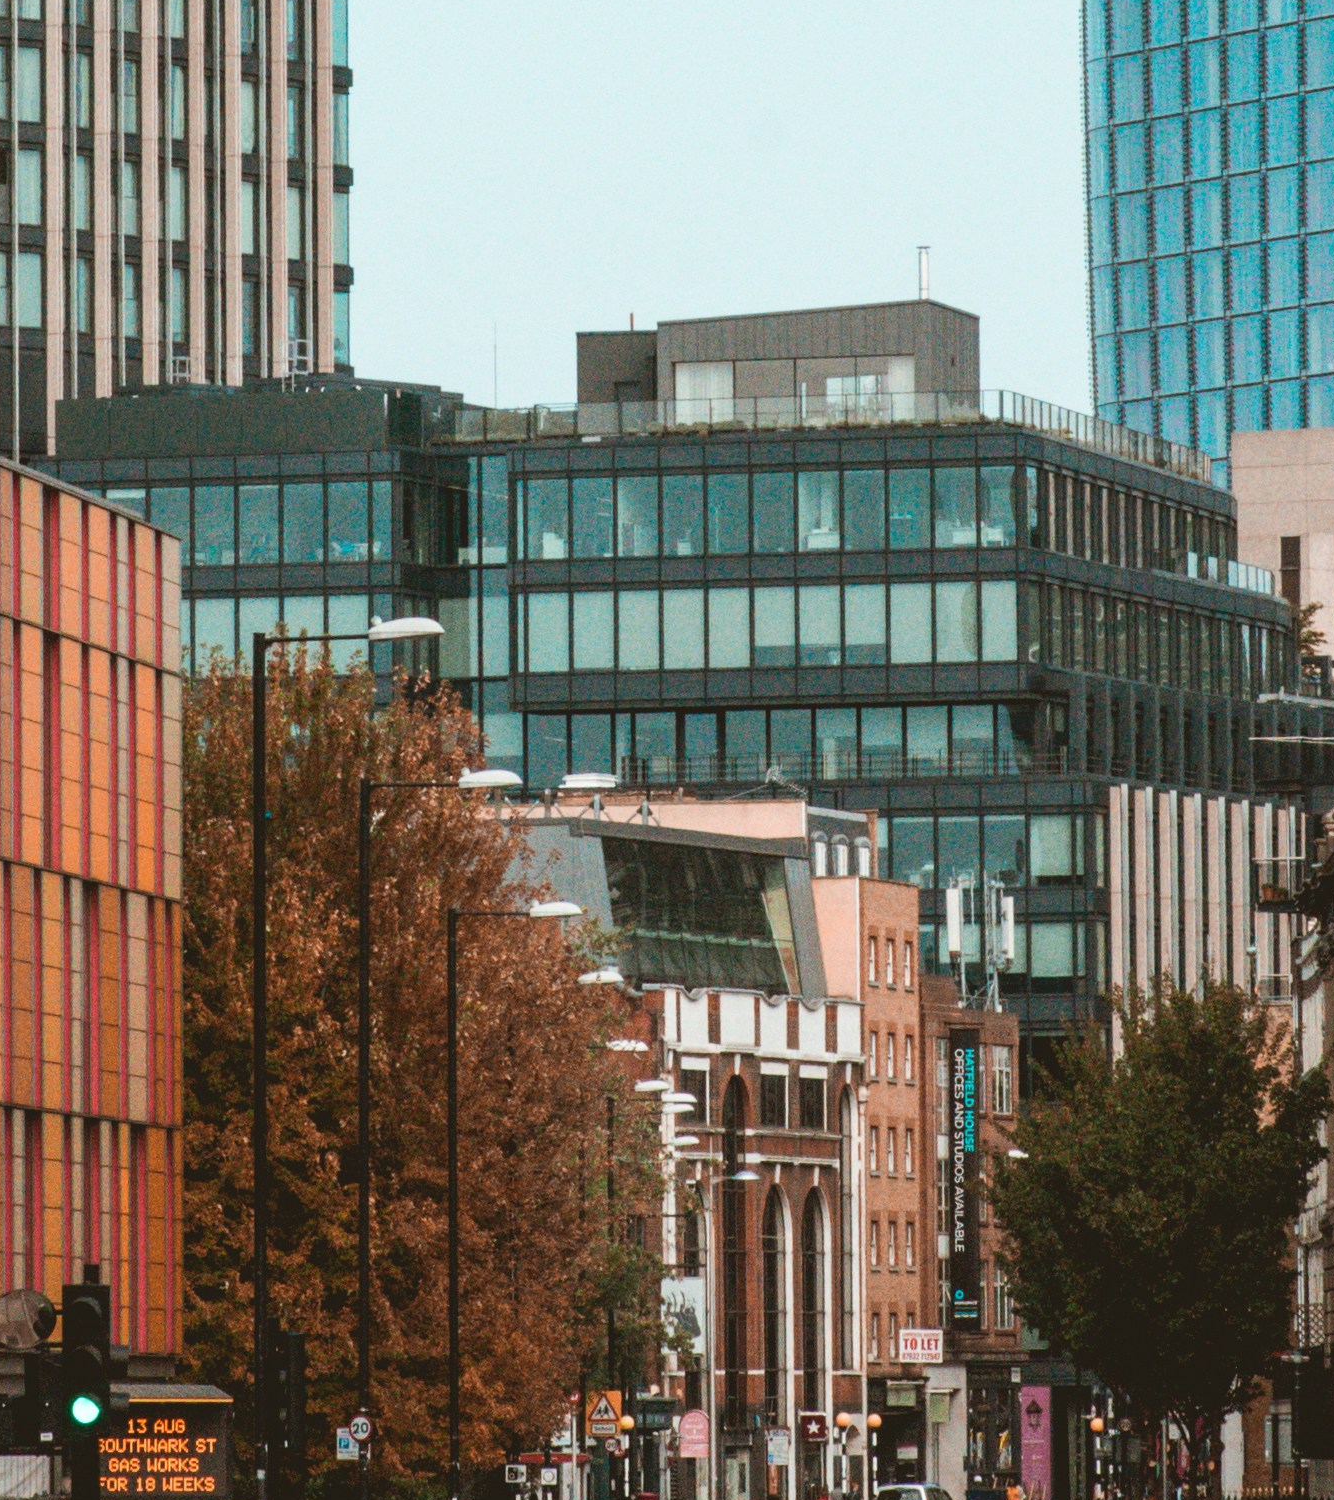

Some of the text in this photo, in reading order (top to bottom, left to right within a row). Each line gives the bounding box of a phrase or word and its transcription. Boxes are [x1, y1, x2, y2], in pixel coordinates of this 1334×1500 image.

[965, 1048, 974, 1153] HATFIELD HOUSE
[954, 1048, 964, 1253] OFFICES AND STUDIOS AVAILABLE
[903, 1337, 940, 1351] TO LET
[127, 1418, 186, 1434] 13 AUG
[352, 1422, 369, 1435] 20
[195, 1438, 217, 1453] ST
[108, 1457, 200, 1473] GAS WORKS
[100, 1477, 128, 1492] FOR
[162, 1477, 215, 1492] WEEKS
